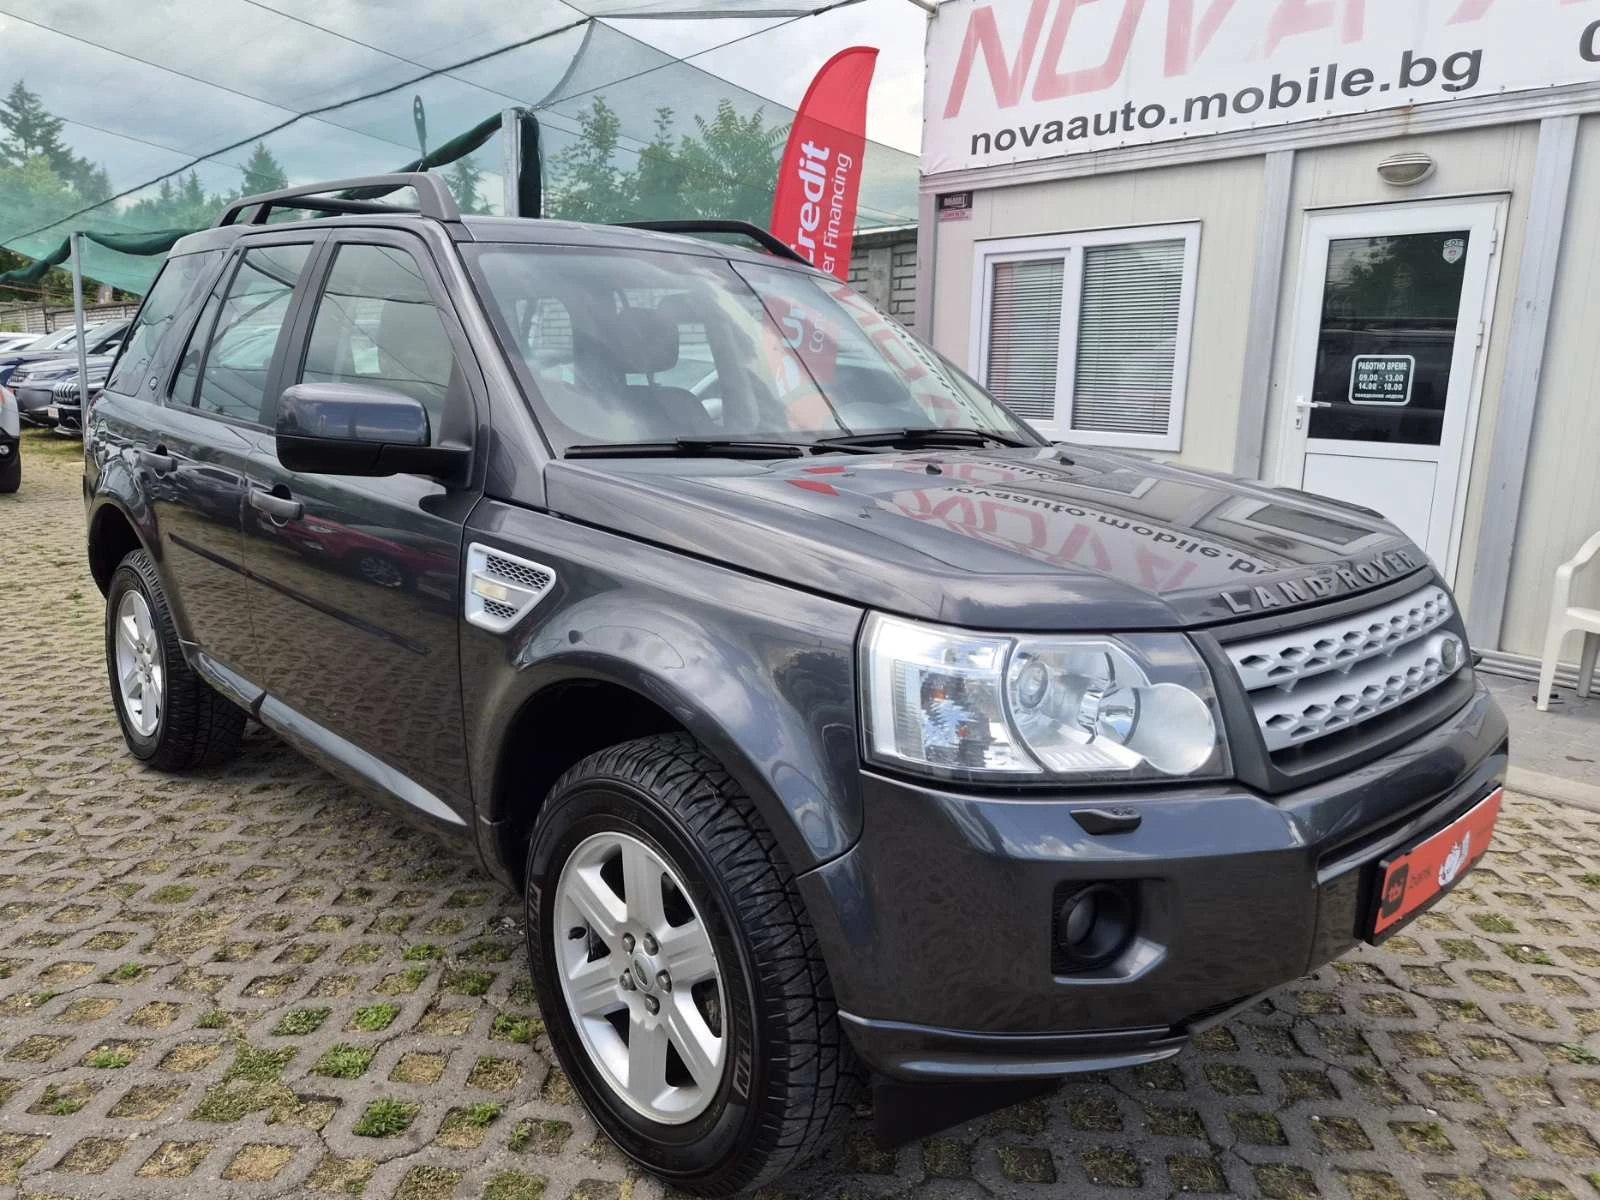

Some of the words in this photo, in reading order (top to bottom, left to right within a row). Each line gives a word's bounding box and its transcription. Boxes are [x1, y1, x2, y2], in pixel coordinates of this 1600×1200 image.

[971, 49, 1483, 155] novaauto.mobile.bg
[823, 153, 853, 249] Financing
[1219, 575, 1332, 614] LAND
[1335, 549, 1417, 591] ROVER
